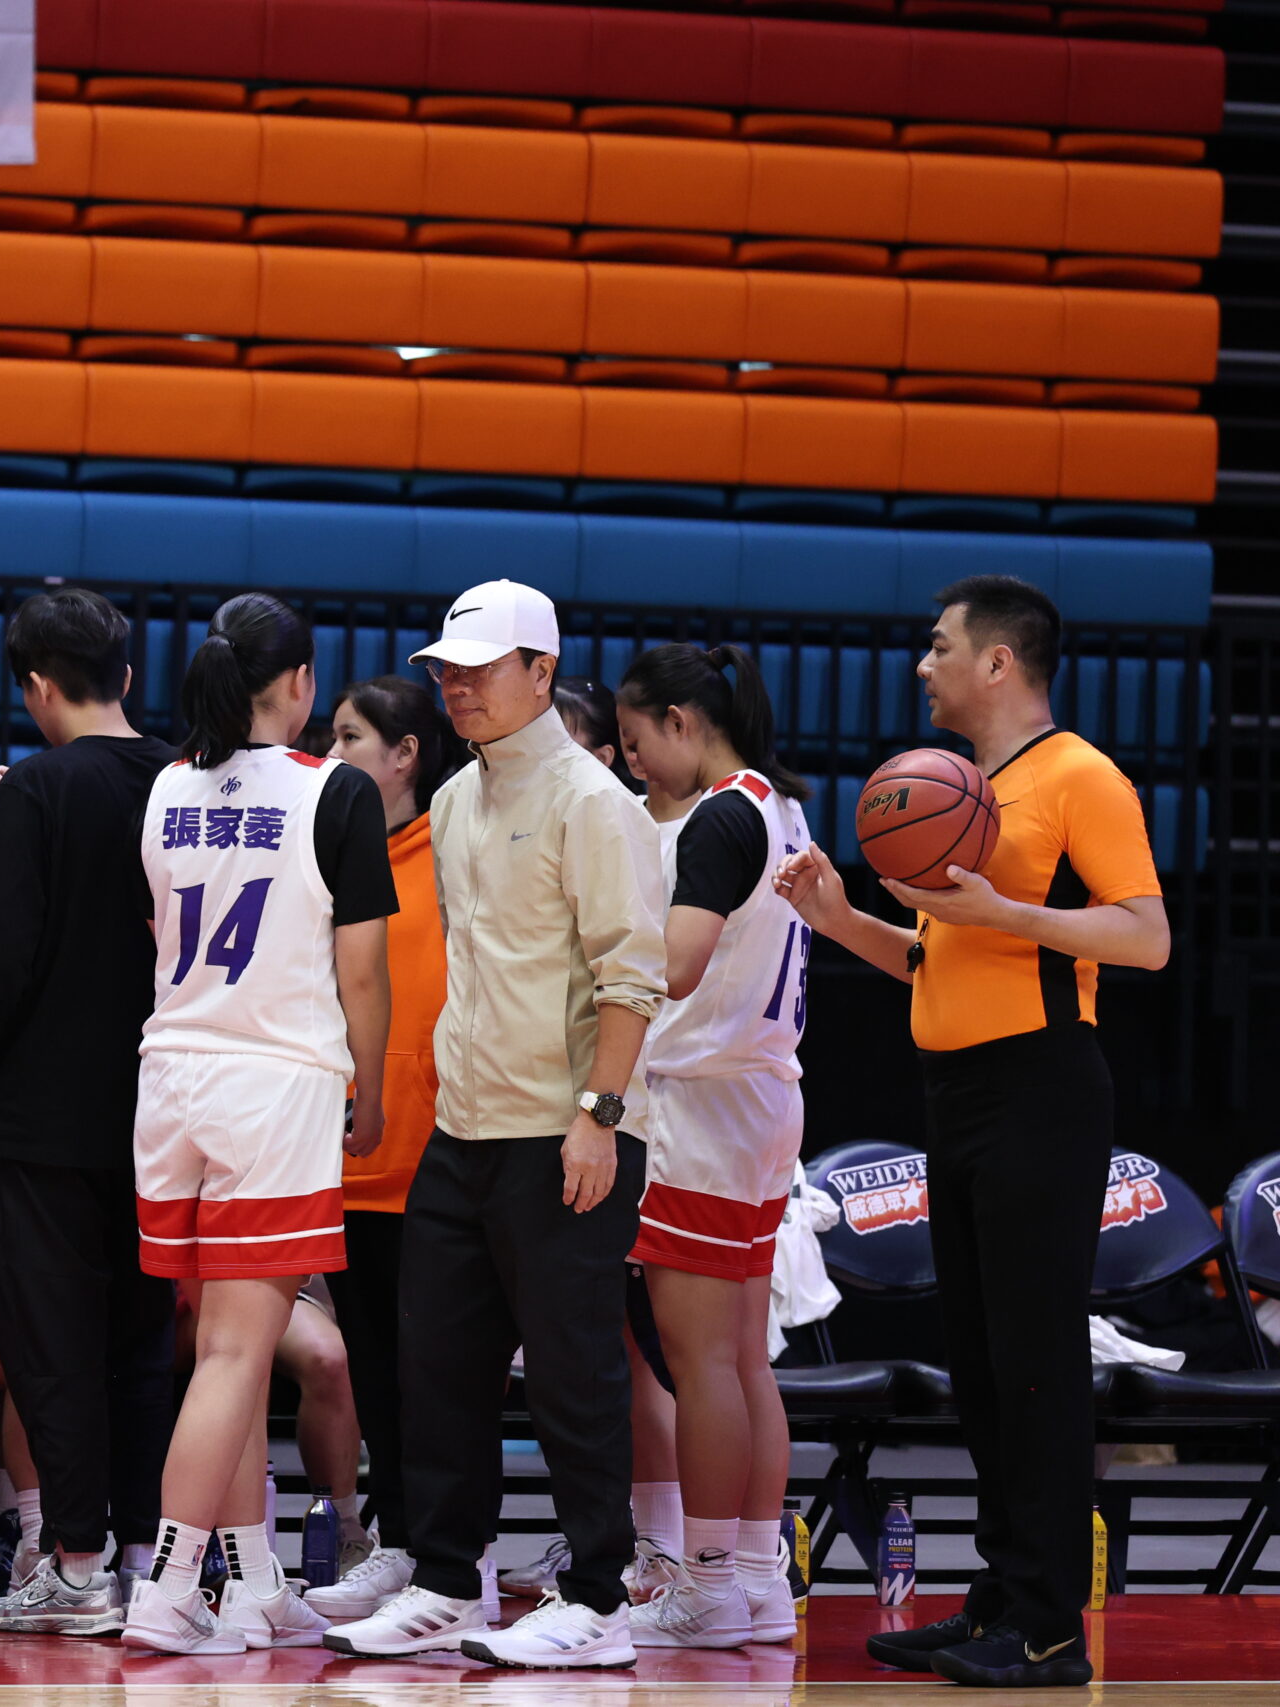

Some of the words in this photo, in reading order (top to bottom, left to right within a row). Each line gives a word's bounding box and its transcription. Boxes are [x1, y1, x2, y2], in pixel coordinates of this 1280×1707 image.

[162, 805, 288, 851] 張家菱
[170, 877, 274, 986] 14
[888, 1538, 913, 1546] CLEAR
